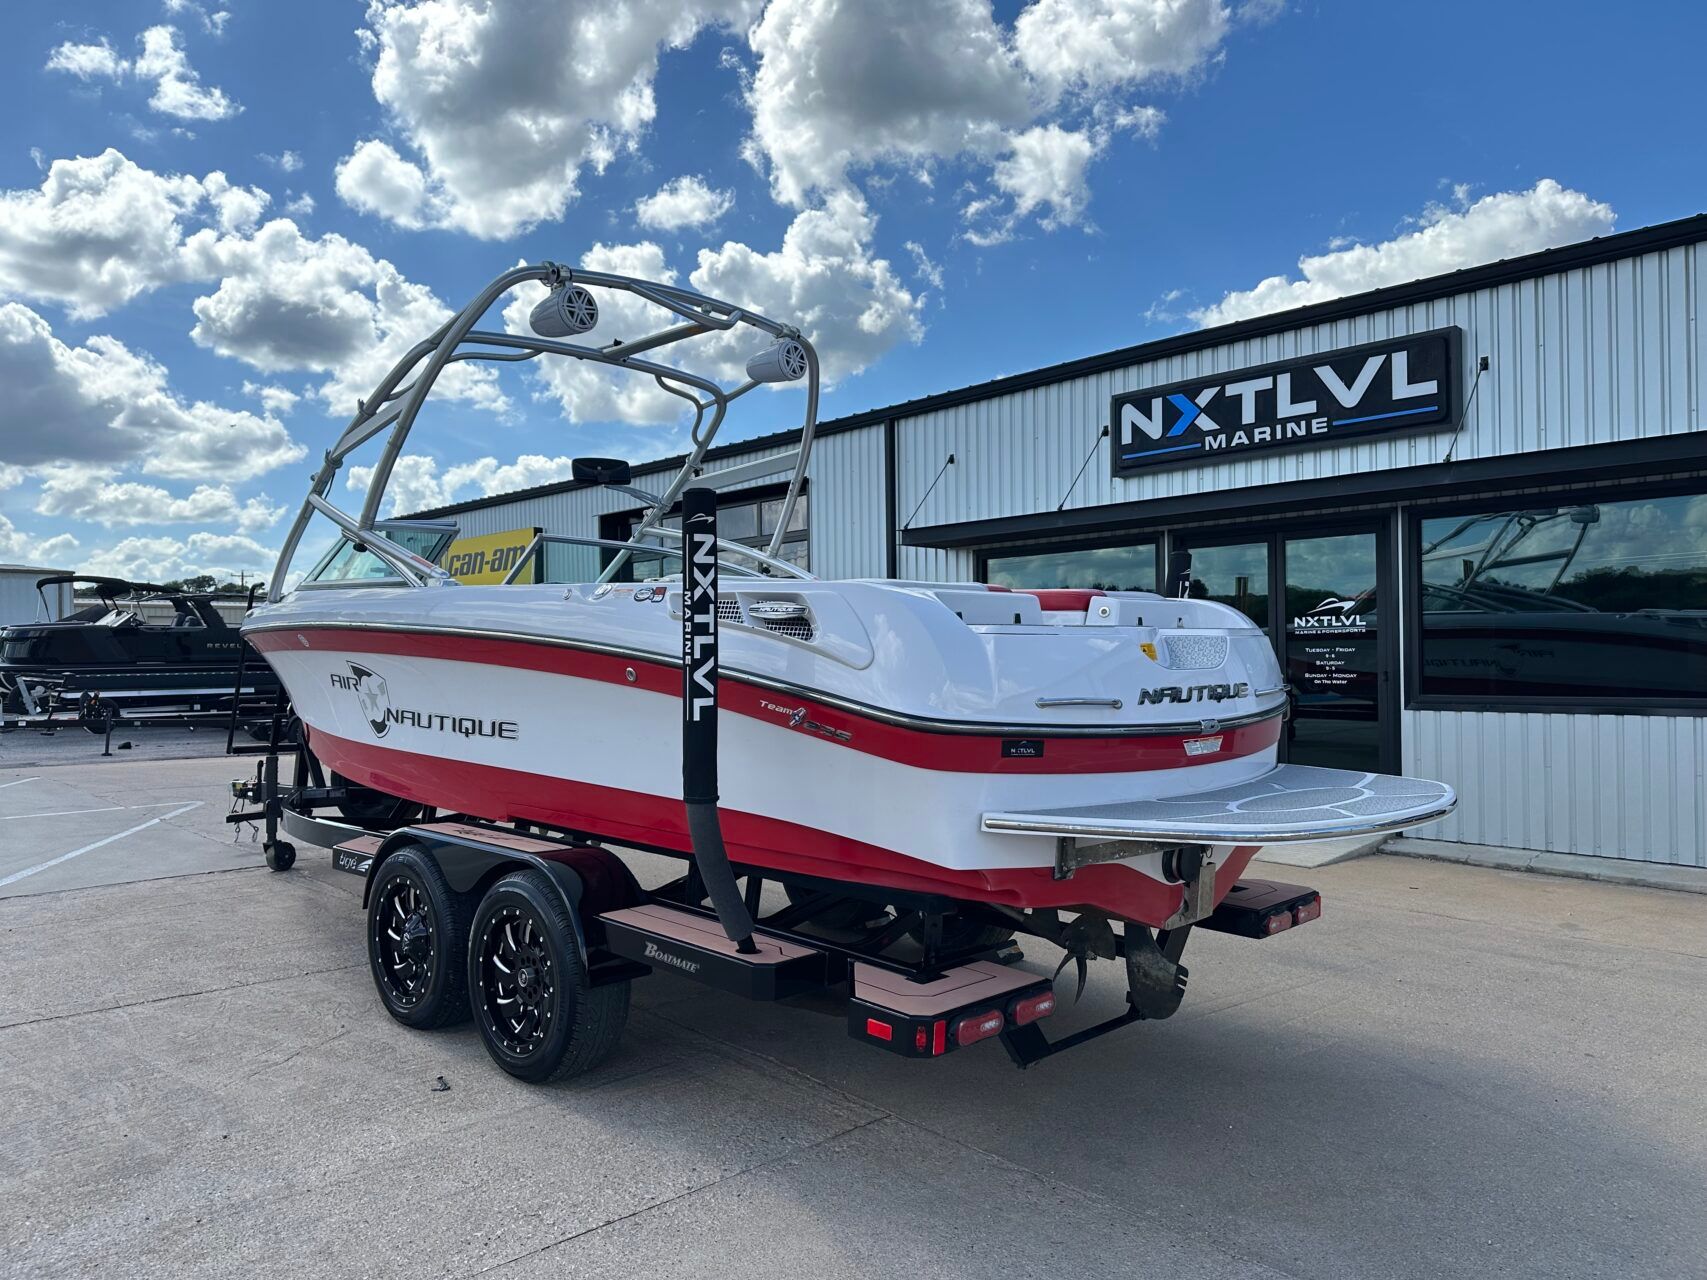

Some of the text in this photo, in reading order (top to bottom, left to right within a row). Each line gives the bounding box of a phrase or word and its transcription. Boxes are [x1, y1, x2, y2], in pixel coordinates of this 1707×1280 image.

[1121, 350, 1438, 446] NXTLVL
[1205, 417, 1329, 451] MARINE
[448, 545, 526, 577] can-am
[684, 590, 692, 665] MARINE
[693, 533, 716, 721] NXTLVL
[1294, 615, 1367, 628] NXTLVL
[330, 673, 359, 692] AIR
[1137, 682, 1249, 705] NAUTIQUE
[386, 707, 520, 740] NAUTIQUE
[760, 700, 794, 715] Team
[644, 941, 698, 973] BOATMATE
